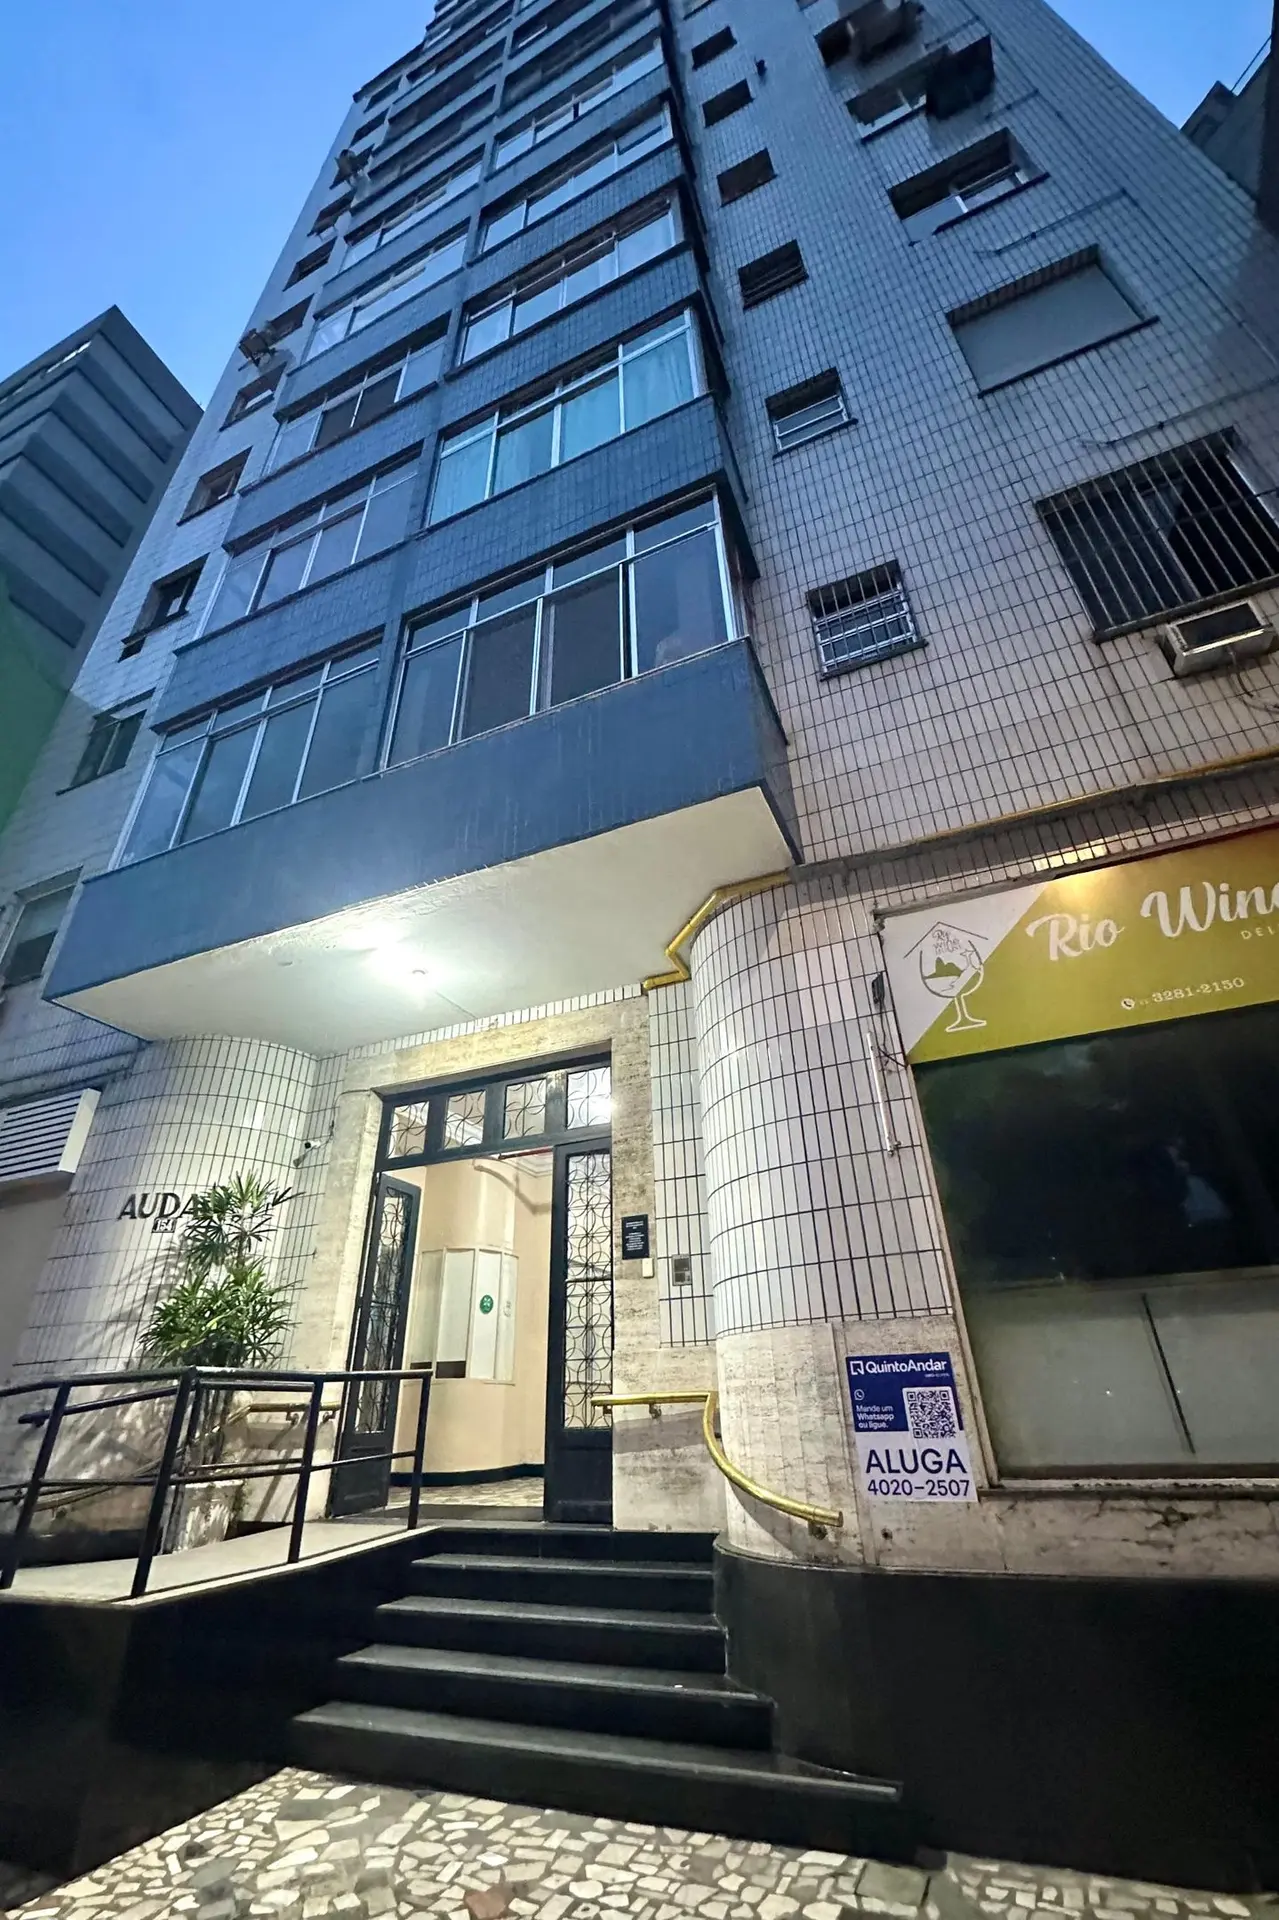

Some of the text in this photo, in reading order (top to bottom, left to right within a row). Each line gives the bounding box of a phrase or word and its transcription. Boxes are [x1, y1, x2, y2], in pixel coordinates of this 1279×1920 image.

[1025, 913, 1125, 961] Rio
[1152, 977, 1244, 1003] 3281-2150
[865, 1358, 947, 1375] QuintoAndar
[857, 1412, 895, 1421] Whatsapp
[858, 1421, 868, 1429] ou
[866, 1448, 967, 1474] ALUGA
[867, 1479, 970, 1496] 4020-2507
